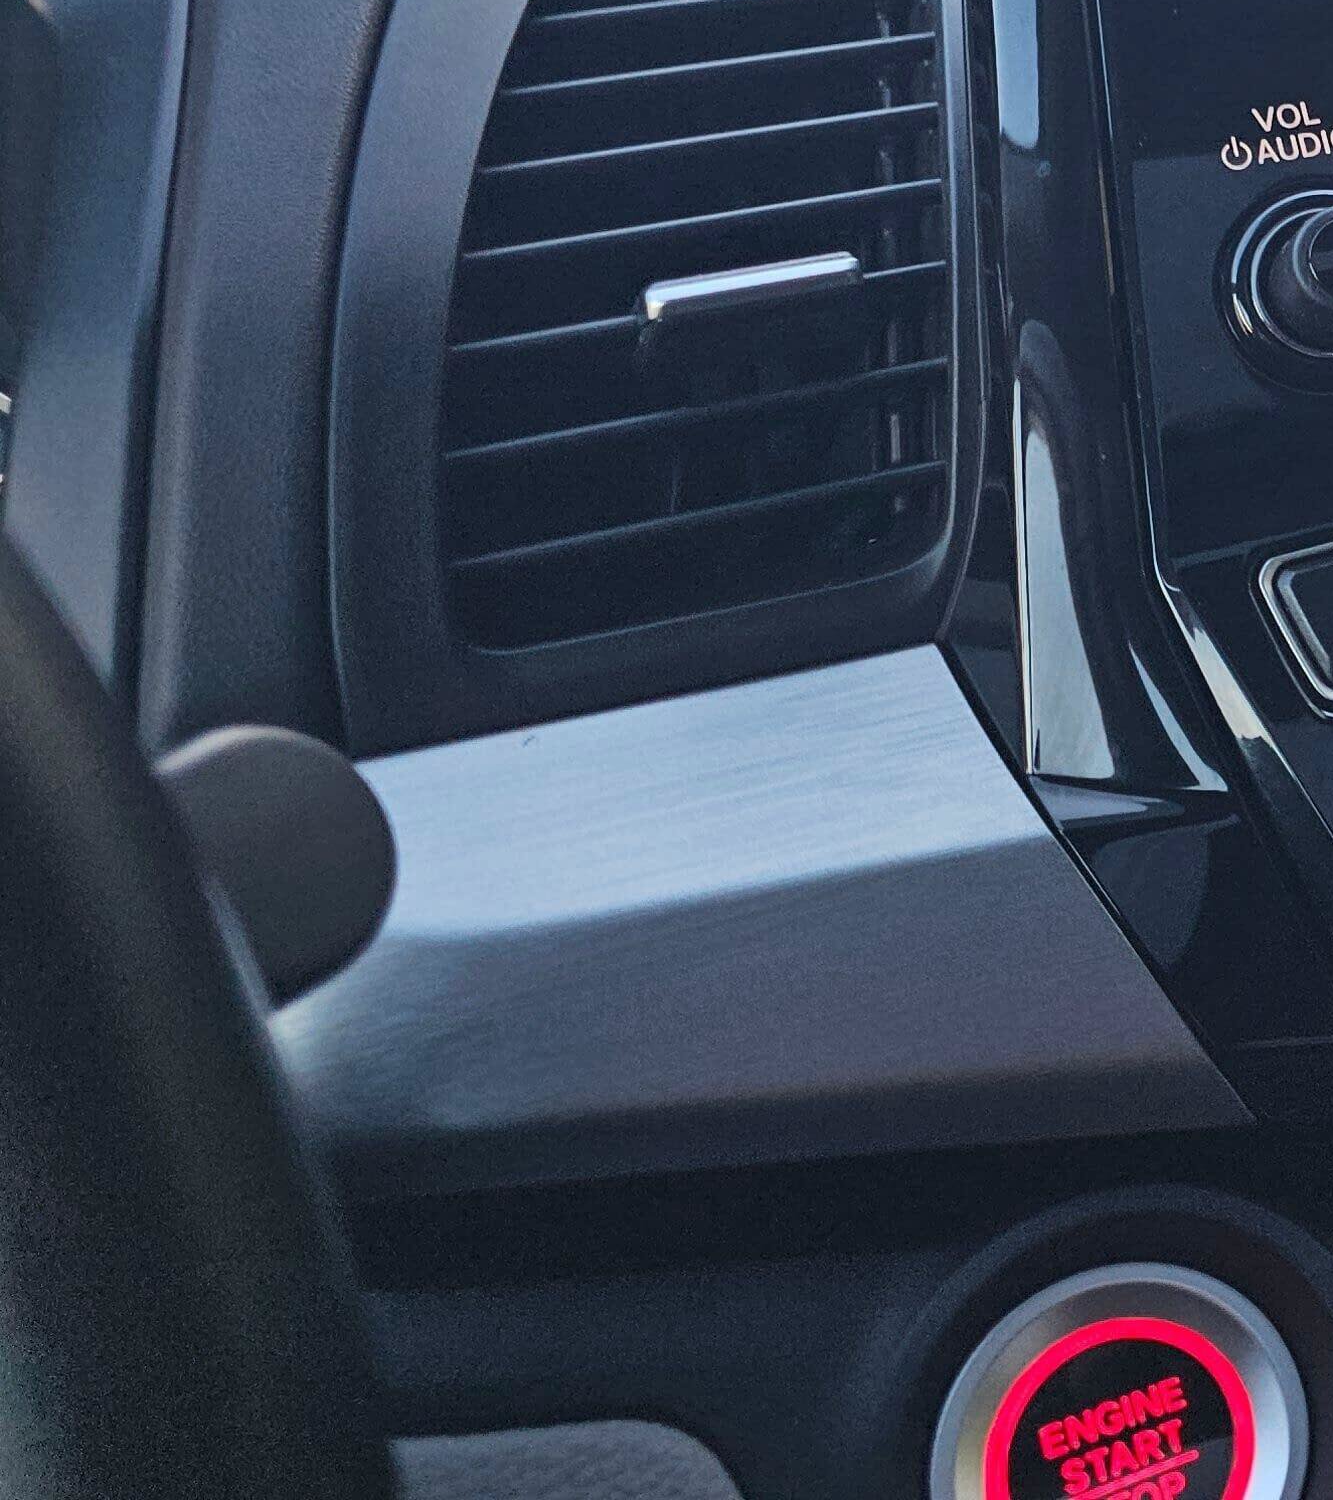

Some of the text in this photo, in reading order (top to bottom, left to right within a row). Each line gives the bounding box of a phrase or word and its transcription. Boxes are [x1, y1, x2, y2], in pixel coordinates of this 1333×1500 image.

[1251, 101, 1321, 133] VOL
[1038, 1376, 1187, 1460] ENGINE
[1060, 1418, 1182, 1494] START
